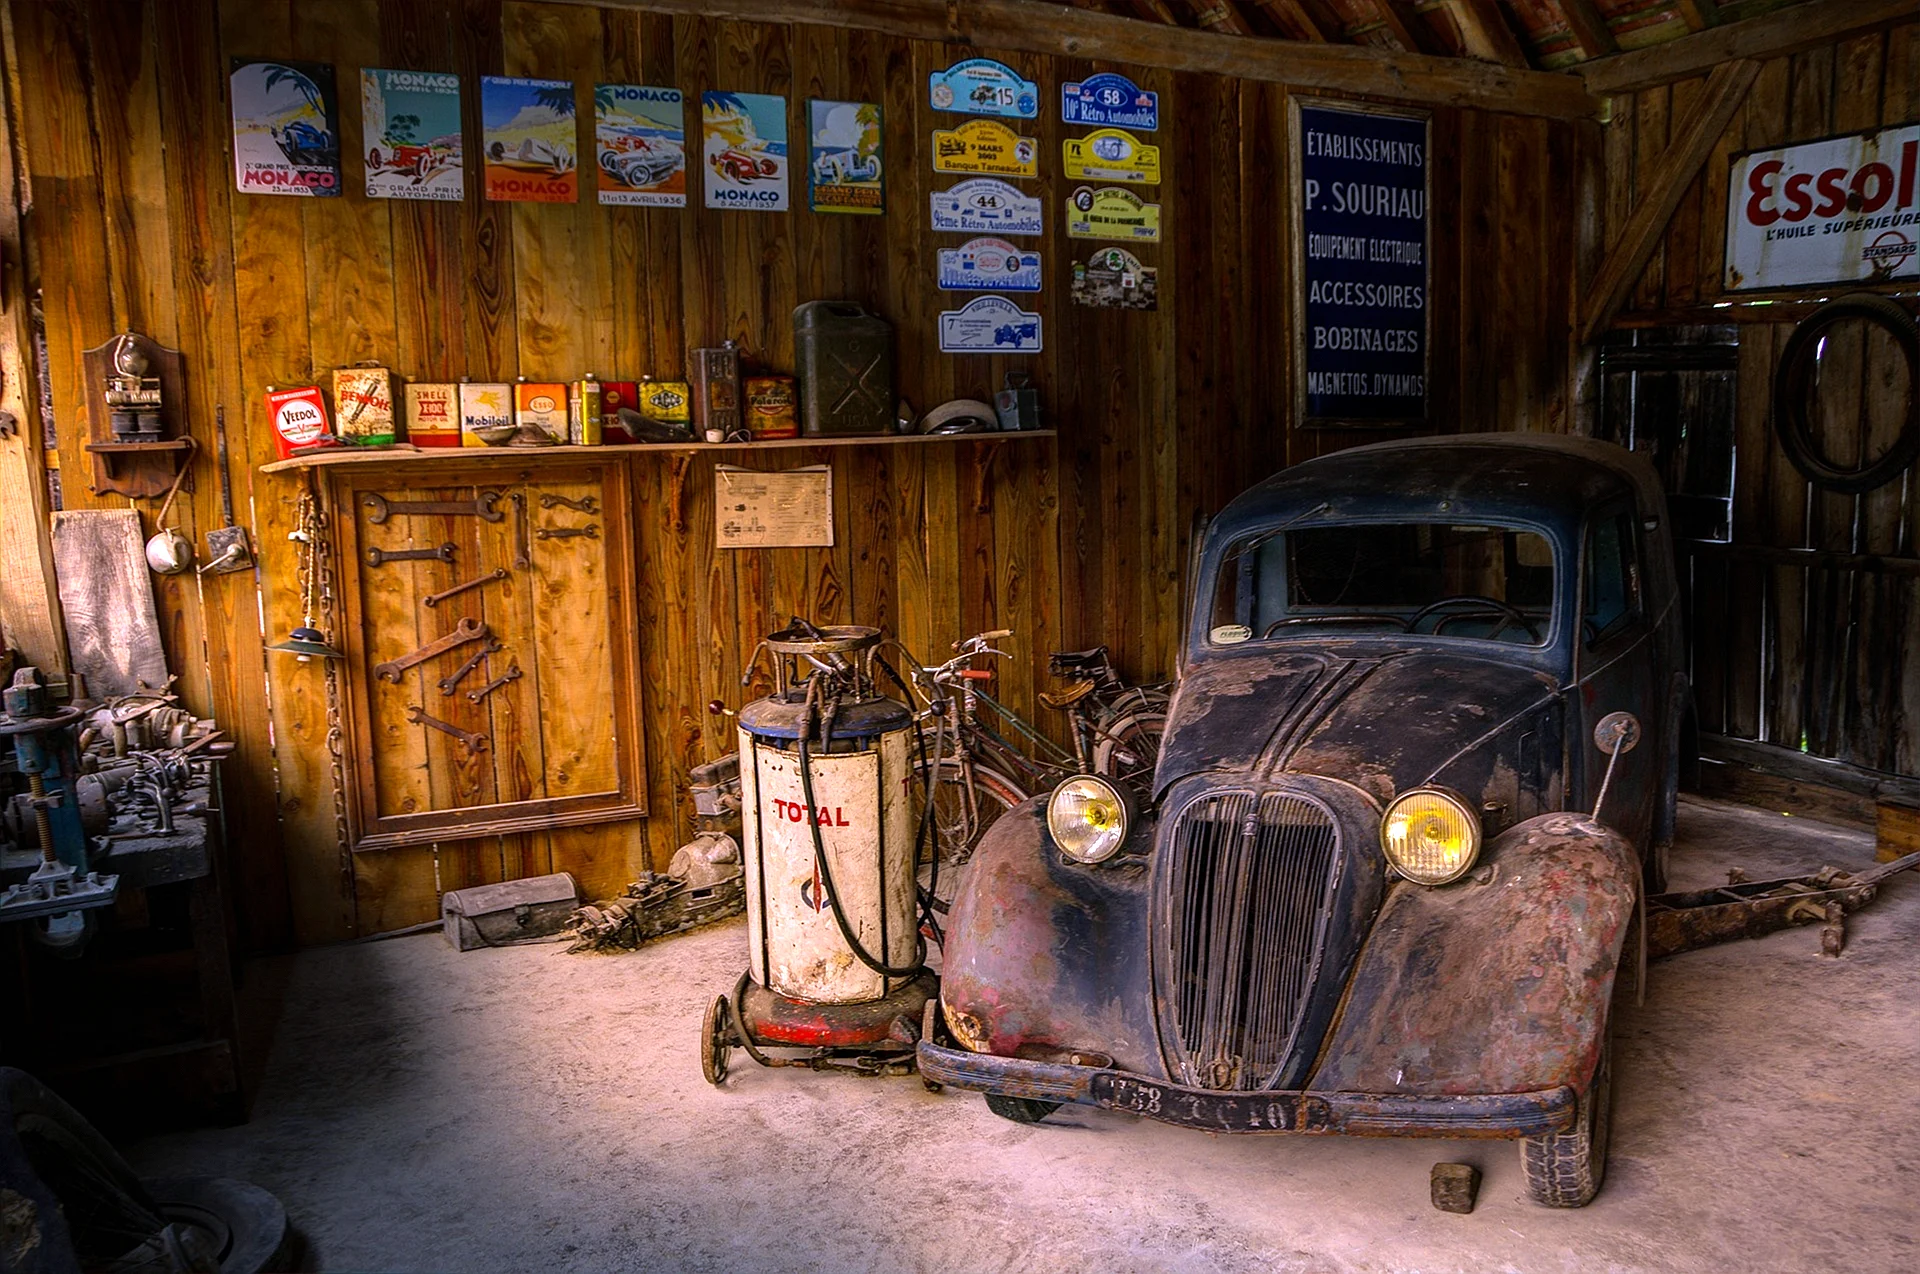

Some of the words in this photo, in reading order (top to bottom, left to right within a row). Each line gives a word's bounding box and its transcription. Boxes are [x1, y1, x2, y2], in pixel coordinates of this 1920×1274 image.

[386, 72, 459, 88] MONACO
[614, 88, 681, 103] MONACO
[998, 88, 1013, 106] 15
[1103, 90, 1120, 105] 58
[1081, 102, 1105, 122] Rétro
[1106, 107, 1155, 127] Automobiles
[978, 144, 1004, 152] MARS
[1306, 128, 1422, 168] ÉTABLISSEMENTS
[944, 160, 979, 173] Banque
[981, 162, 1021, 173] Tarneaud
[244, 168, 335, 189] MONACO
[1746, 140, 1918, 226] Essol
[389, 184, 428, 192] GRAND
[434, 186, 462, 194] PRIX
[492, 180, 571, 195] MONACO
[390, 191, 464, 200] AUTOMOBILE
[630, 196, 657, 204] AVRIL
[658, 197, 682, 205] 1936
[714, 189, 779, 202] MONACO
[977, 196, 997, 208] 44
[1331, 180, 1424, 220] SOURIAU
[934, 209, 958, 228] 9ème
[961, 216, 986, 229] Rétro
[988, 216, 1041, 232] Automobiles
[1766, 224, 1816, 242] L'HUILE
[1822, 211, 1920, 235] SUPÉRIEURE
[1308, 230, 1367, 261] ÉQUIPEMENT
[1862, 244, 1918, 259] STANDARD
[1309, 280, 1424, 310] ACCESSOIRES
[1313, 325, 1419, 353] BOBINAGES
[416, 391, 447, 400] SHELL
[422, 402, 444, 414] X-100
[282, 408, 317, 424] VEEDOL
[466, 416, 510, 426] Mobiloil
[602, 417, 620, 425] X-10
